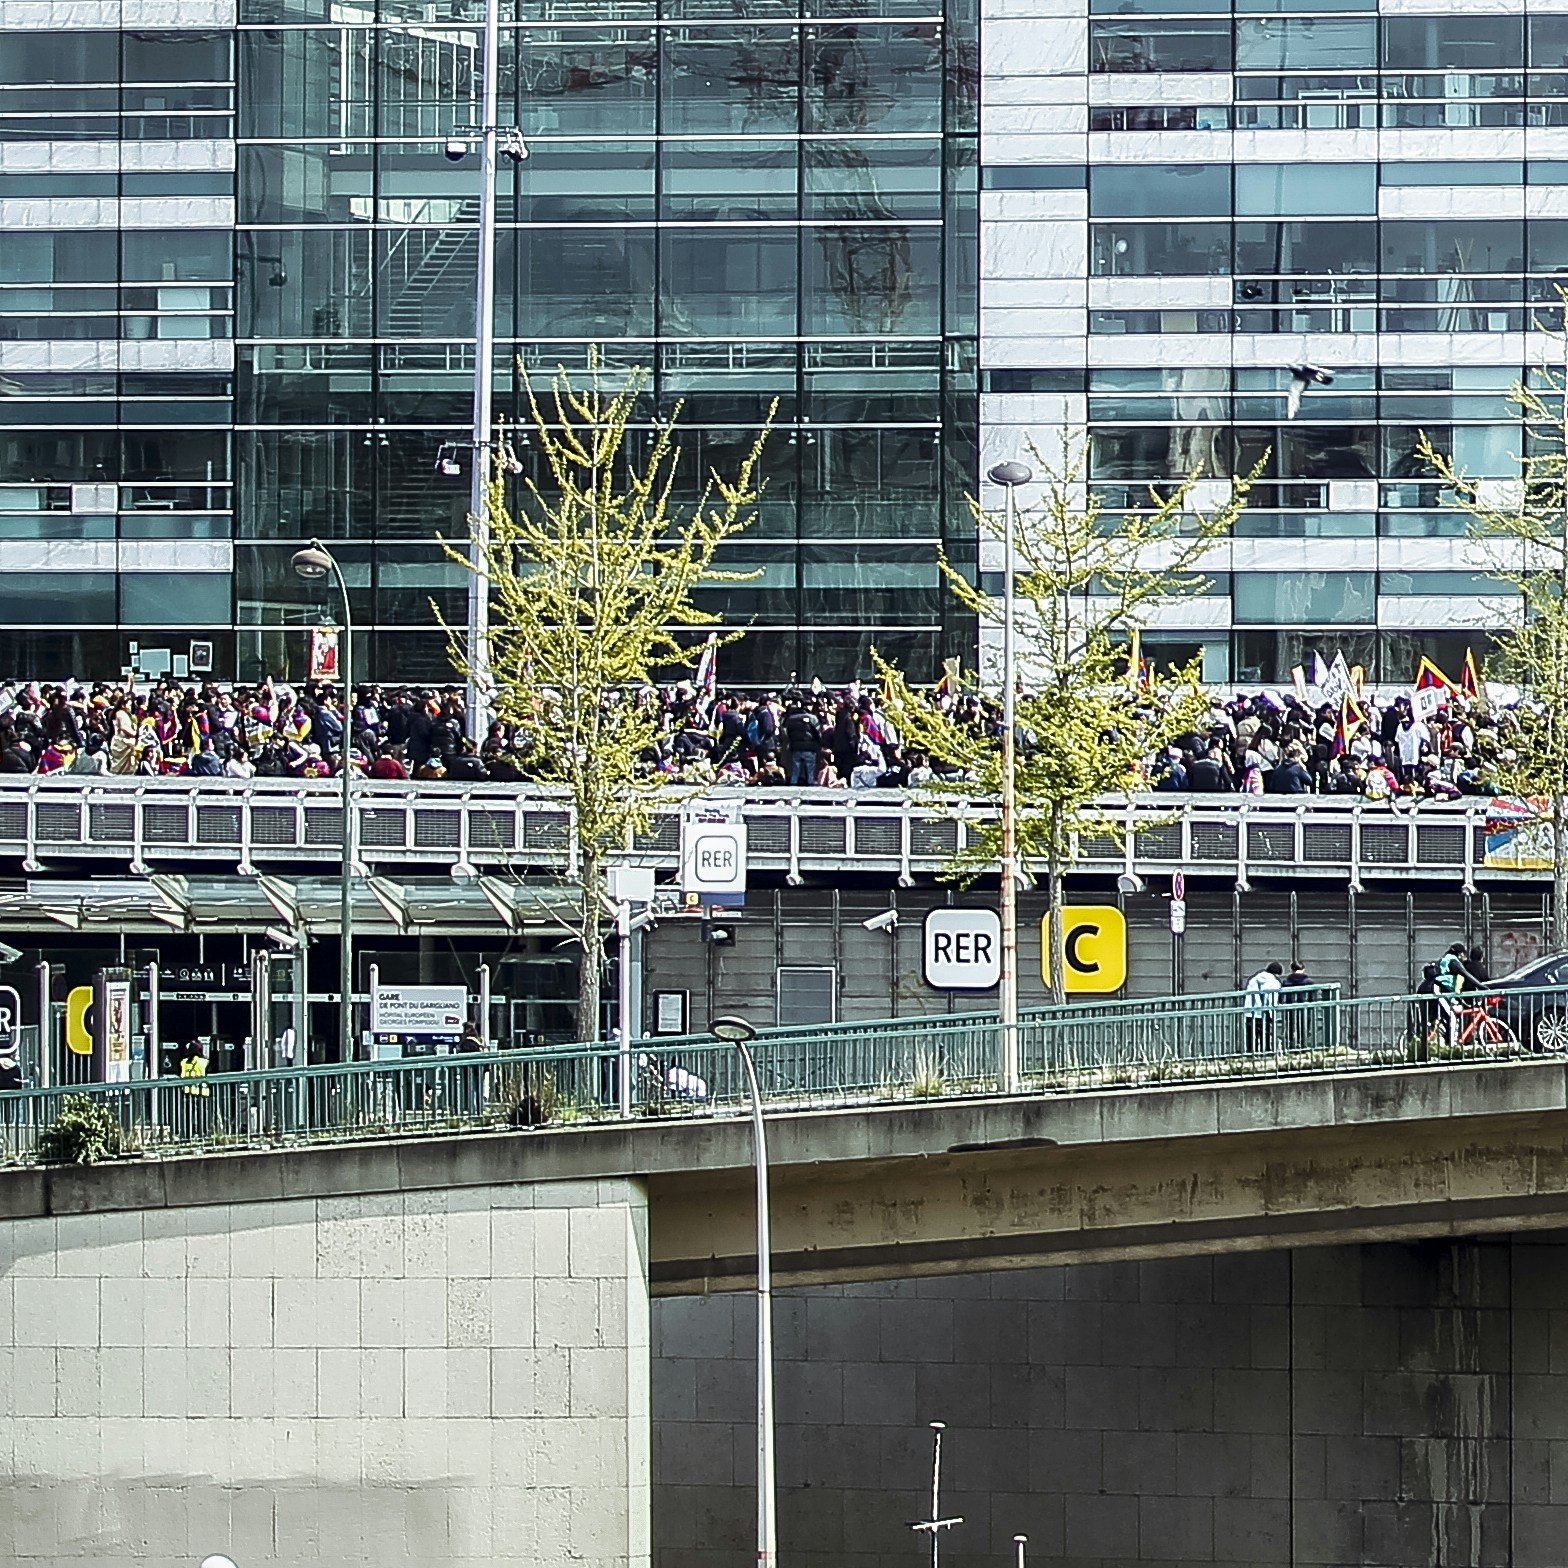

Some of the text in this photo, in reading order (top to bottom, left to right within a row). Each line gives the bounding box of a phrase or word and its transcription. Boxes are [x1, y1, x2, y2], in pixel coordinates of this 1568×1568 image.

[701, 850, 732, 868] RER
[934, 924, 1100, 974] RER C
[378, 993, 400, 1001] GARE
